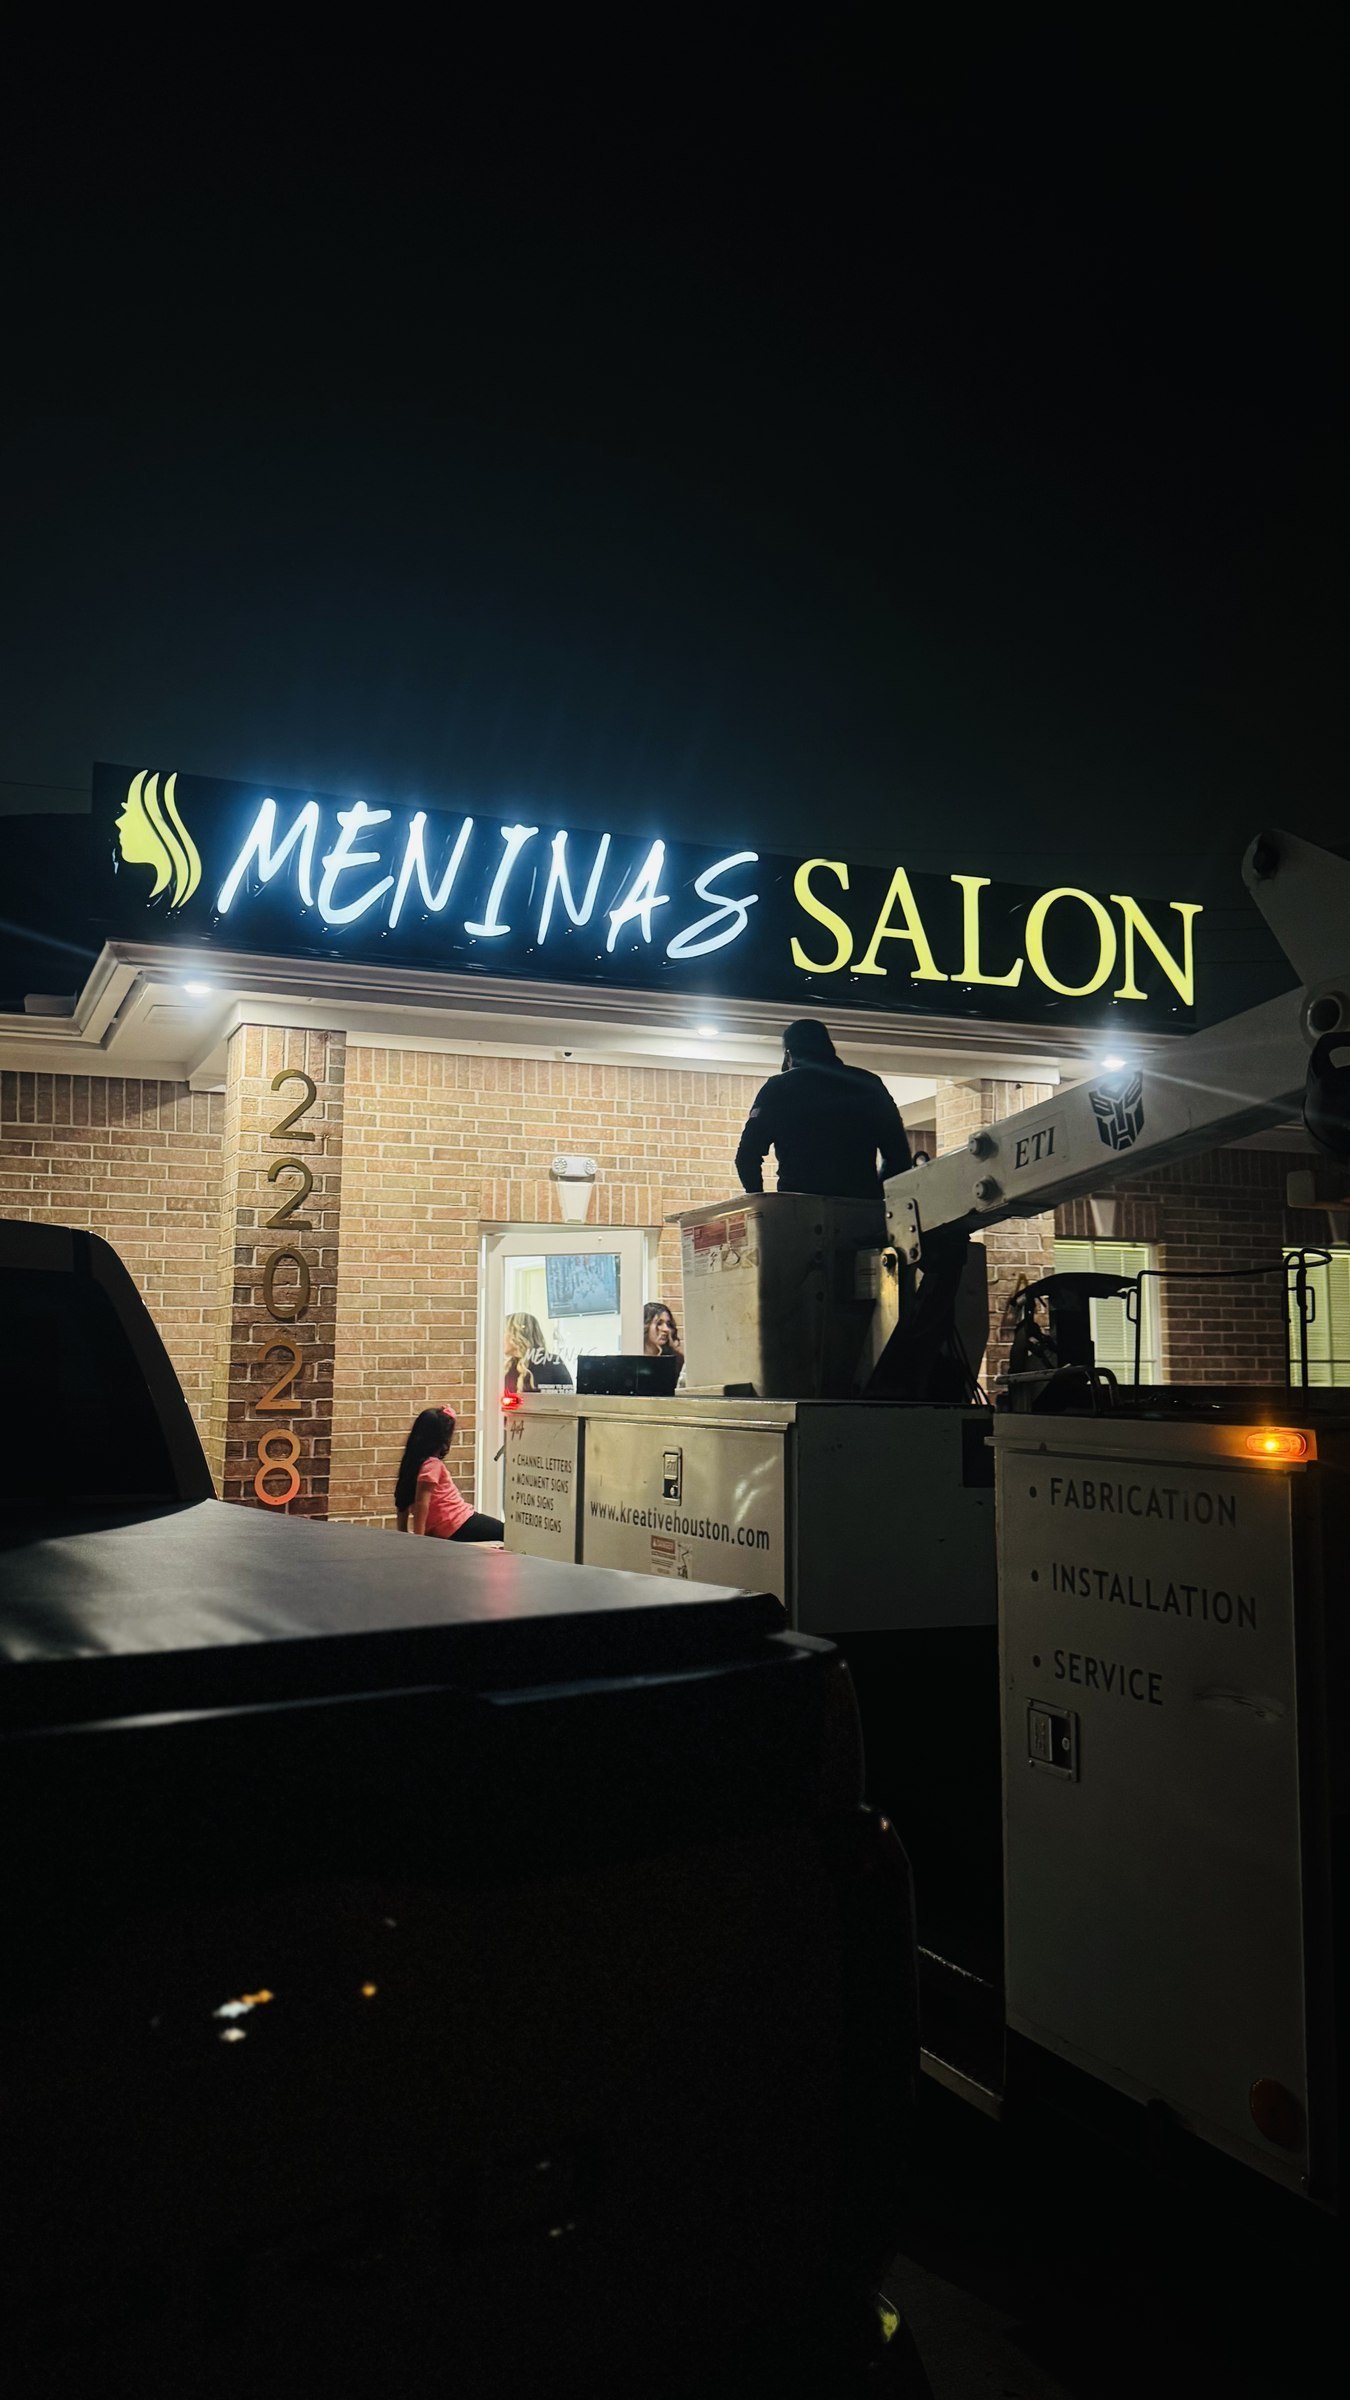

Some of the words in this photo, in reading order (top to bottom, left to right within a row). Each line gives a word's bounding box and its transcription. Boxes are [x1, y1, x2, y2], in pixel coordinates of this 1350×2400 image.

[218, 796, 760, 960] MENINAS
[790, 858, 1204, 1006] SALON
[1014, 1126, 1055, 1169] ETI
[253, 1068, 318, 1507] 22028
[516, 1473, 550, 1490] MONUMENT
[551, 1478, 569, 1494] SIGNS
[517, 1454, 544, 1470] CHANNEL
[545, 1458, 572, 1473] LETTERS
[515, 1511, 543, 1528] INTERIOR
[544, 1517, 562, 1533] SIGNS
[516, 1491, 535, 1507] PYLON
[536, 1495, 554, 1511] SIGNS
[590, 1500, 770, 1551] www.kreativehouston.com
[1050, 1477, 1237, 1528] FABRICATION
[1052, 1562, 1258, 1631] INSTALLATION
[1053, 1650, 1163, 1706] SERVICE
